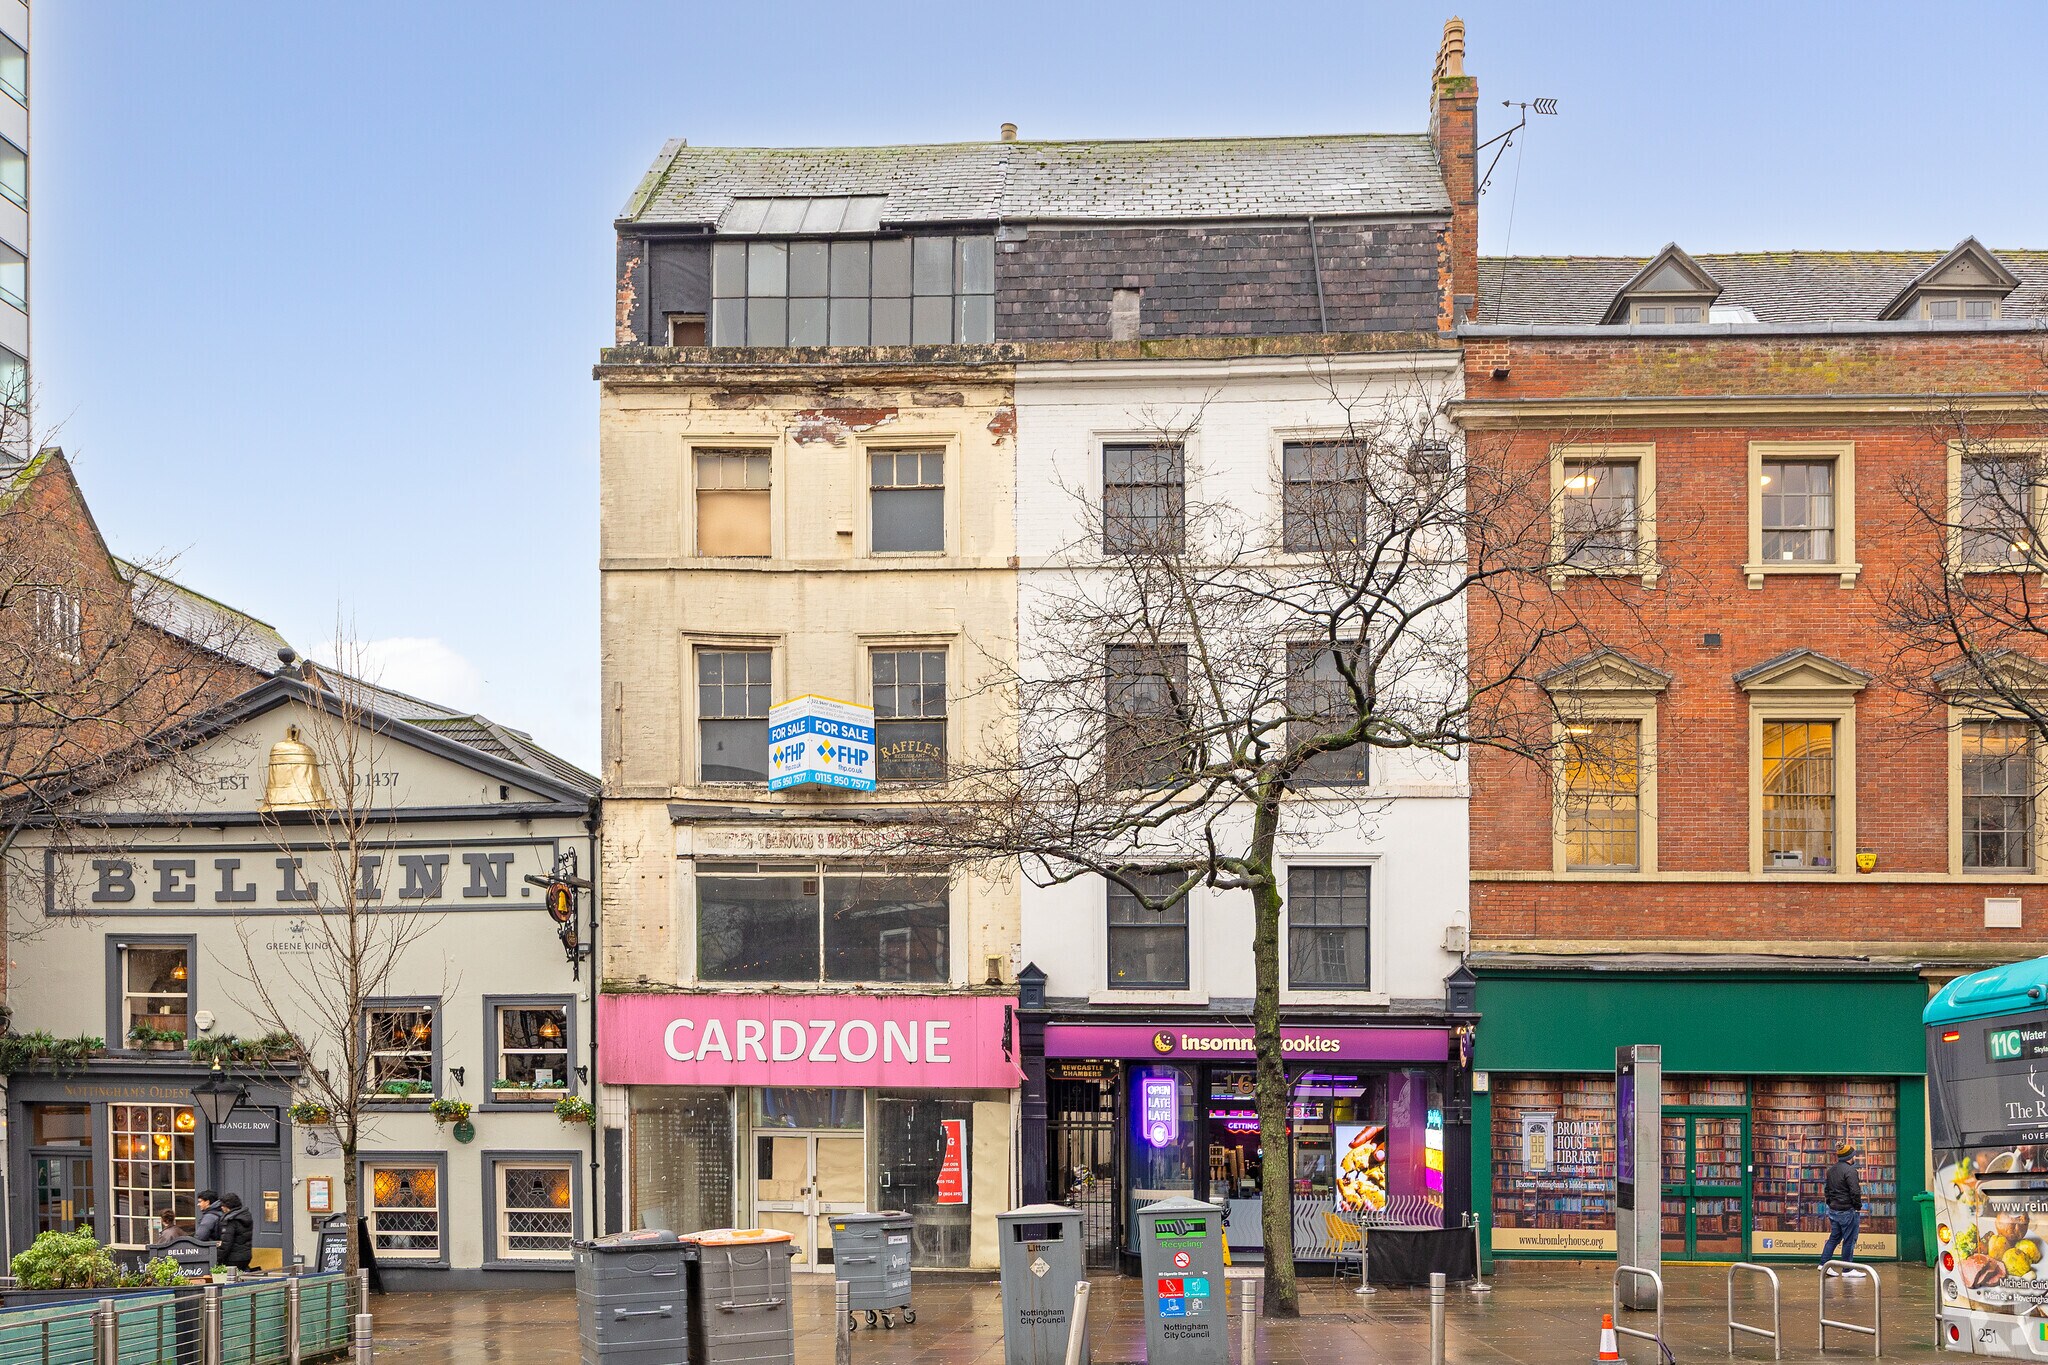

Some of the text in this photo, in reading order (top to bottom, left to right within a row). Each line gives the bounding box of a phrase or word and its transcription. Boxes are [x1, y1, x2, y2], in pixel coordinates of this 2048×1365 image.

[772, 720, 806, 741] FOR SALE
[815, 720, 869, 741] FOR SALE
[785, 741, 806, 763] FHP
[838, 745, 869, 766] FHP
[880, 740, 940, 759] RAFFLES
[838, 763, 863, 774] fhp.co.uk
[219, 776, 250, 790] EST
[365, 772, 399, 787] 1437
[783, 777, 792, 785] 950
[793, 772, 807, 782] 7577
[815, 772, 871, 790] 0115 950 7577
[92, 857, 319, 903] BELL
[266, 942, 329, 950] GREENE KING
[663, 1018, 951, 1063] CARDZONE
[1181, 1034, 1341, 1052] insomn ookies
[1991, 1030, 2047, 1057] 11C Water
[1147, 1085, 1171, 1096] OPEN
[1223, 1074, 1255, 1094] 16
[150, 1086, 190, 1099] OLDEST
[1148, 1097, 1171, 1108] LATE
[1148, 1110, 1171, 1121] LATE
[2005, 1101, 2033, 1119] The
[253, 1122, 271, 1130] ROW
[1228, 1122, 1258, 1130] GETTING
[1556, 1121, 1601, 1136] BROMLEY
[1556, 1136, 1588, 1149] HOUSE
[1556, 1150, 1599, 1164] LIBRARY
[1515, 1180, 1536, 1188] Discover
[1536, 1180, 1568, 1190] Nottingham's
[1161, 1240, 1203, 1250] Recycling
[1519, 1233, 1604, 1249] www.bromleyhouse.org
[1027, 1244, 1050, 1252] Litter
[1999, 1278, 2048, 1290] Michelin Guid
[1985, 1291, 2000, 1300] Main
[2000, 1292, 2008, 1300] St
[1020, 1308, 1065, 1318] Nottingham
[1020, 1316, 1066, 1326] City Council
[1164, 1323, 1209, 1333] Nottingham
[1164, 1331, 1210, 1340] City Council
[1978, 1328, 1998, 1344] 251
